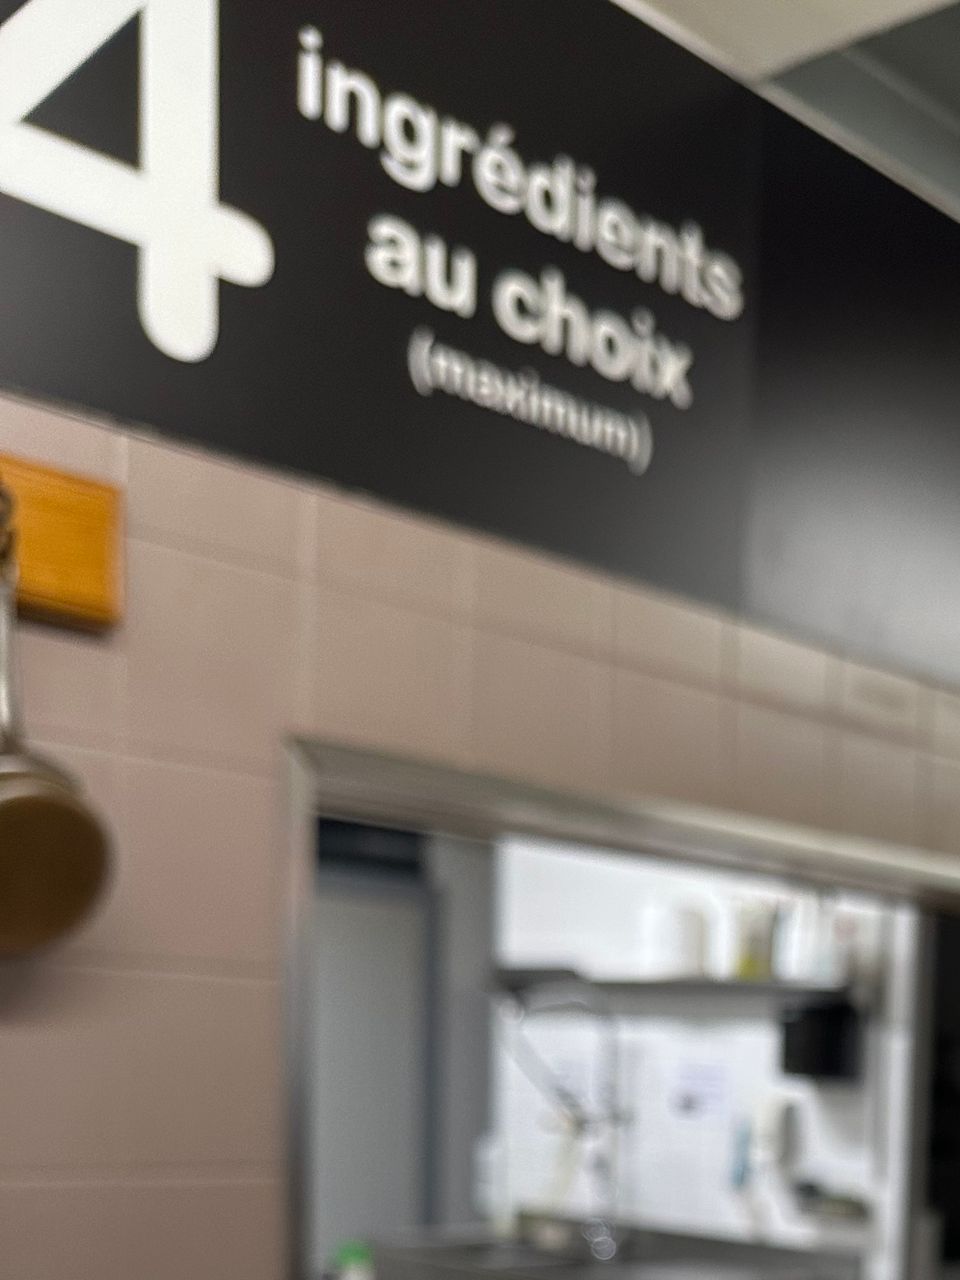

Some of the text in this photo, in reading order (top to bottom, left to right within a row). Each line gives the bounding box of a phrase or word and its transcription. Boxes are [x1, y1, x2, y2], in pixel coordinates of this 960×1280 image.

[0, 0, 275, 362] 4
[298, 26, 745, 320] ingrédients
[365, 213, 693, 408] au choix
[407, 326, 653, 475] (maximum)
